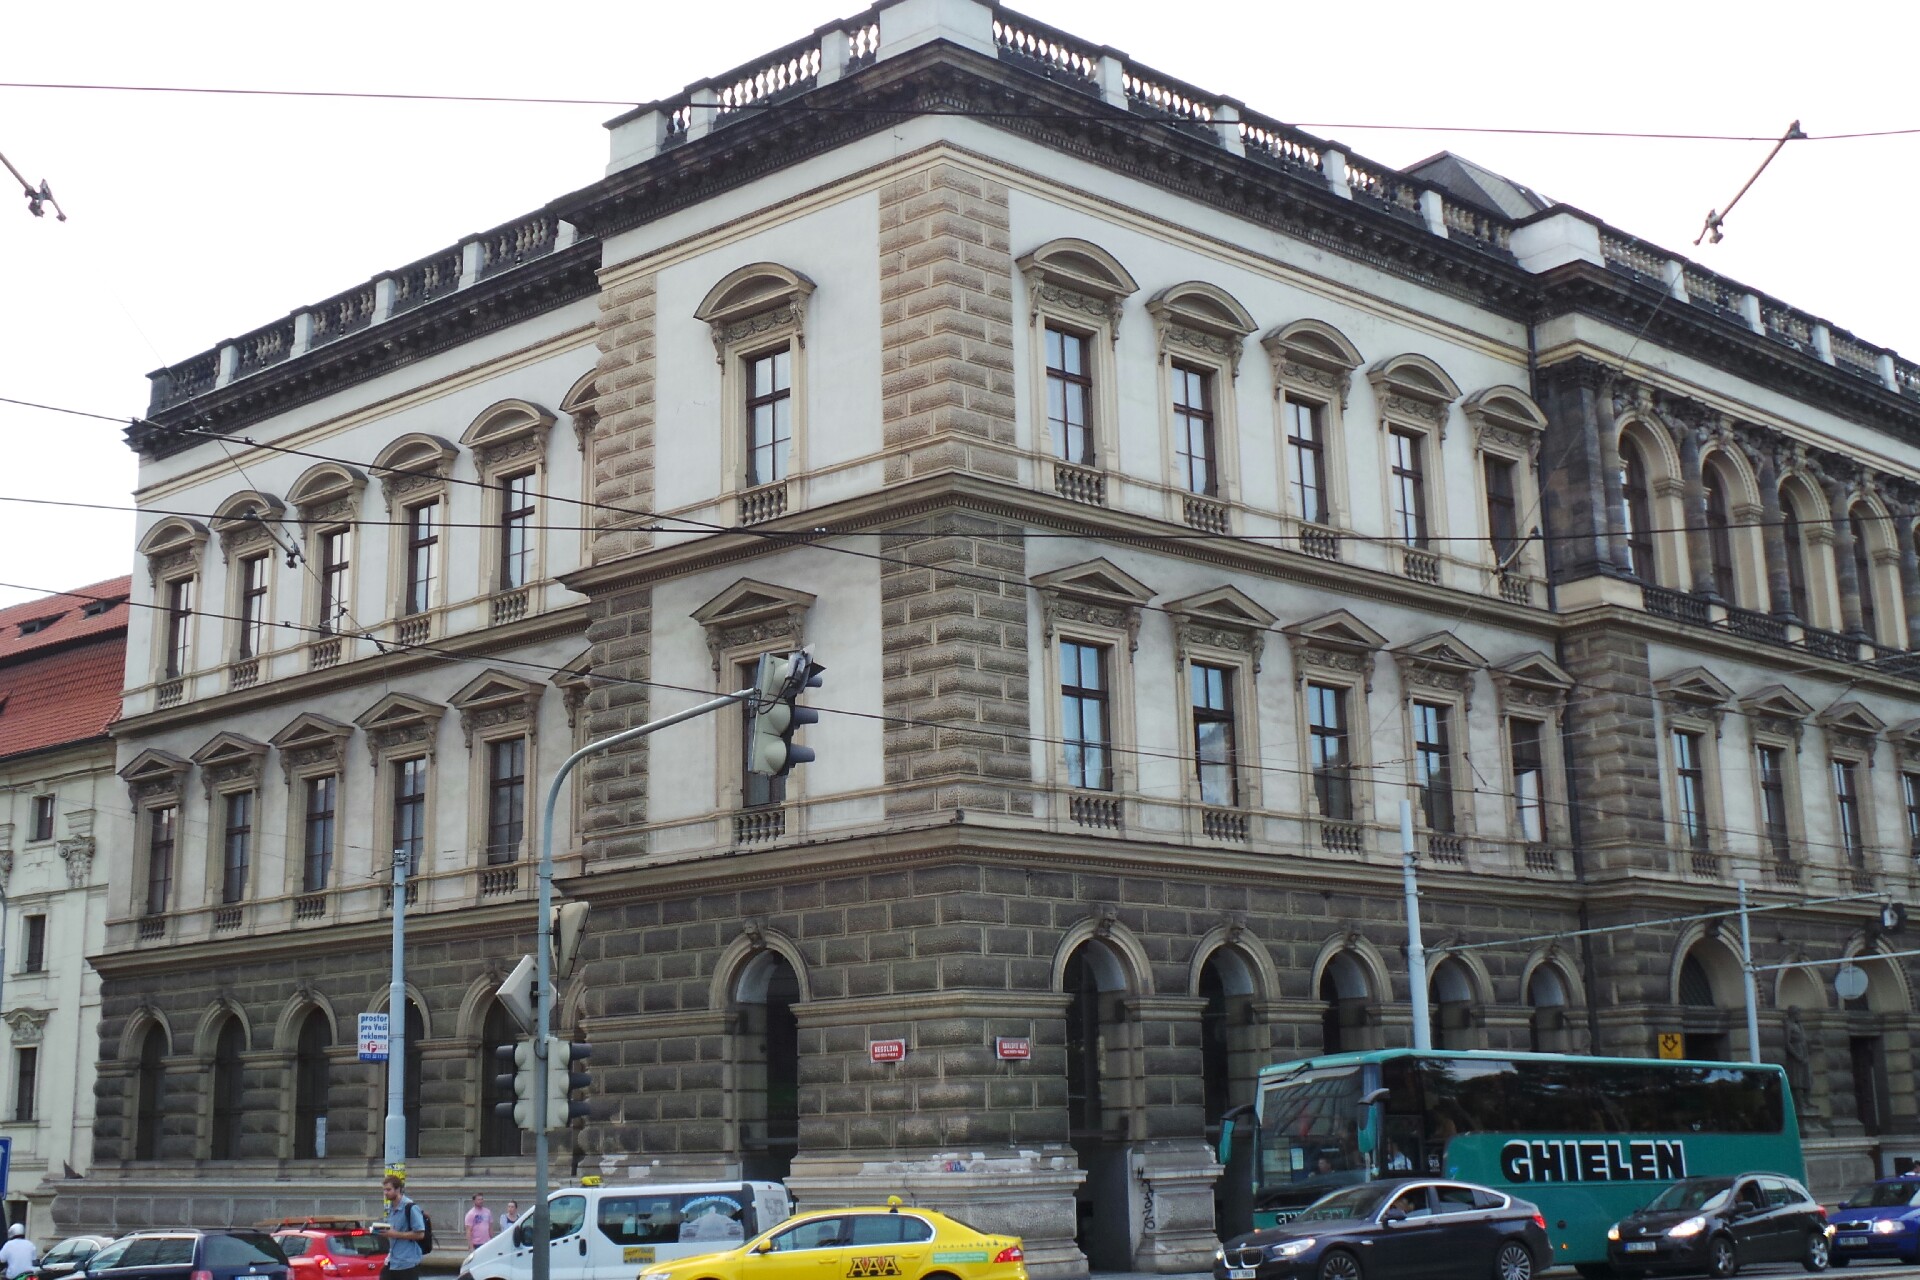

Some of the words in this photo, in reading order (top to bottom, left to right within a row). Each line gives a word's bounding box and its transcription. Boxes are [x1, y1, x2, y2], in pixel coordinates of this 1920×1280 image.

[360, 1015, 387, 1023] prostor
[360, 1024, 372, 1032] pro
[360, 1032, 387, 1040] reklamu
[1501, 1139, 1687, 1184] GHIELEN
[847, 1255, 902, 1279] AAA
